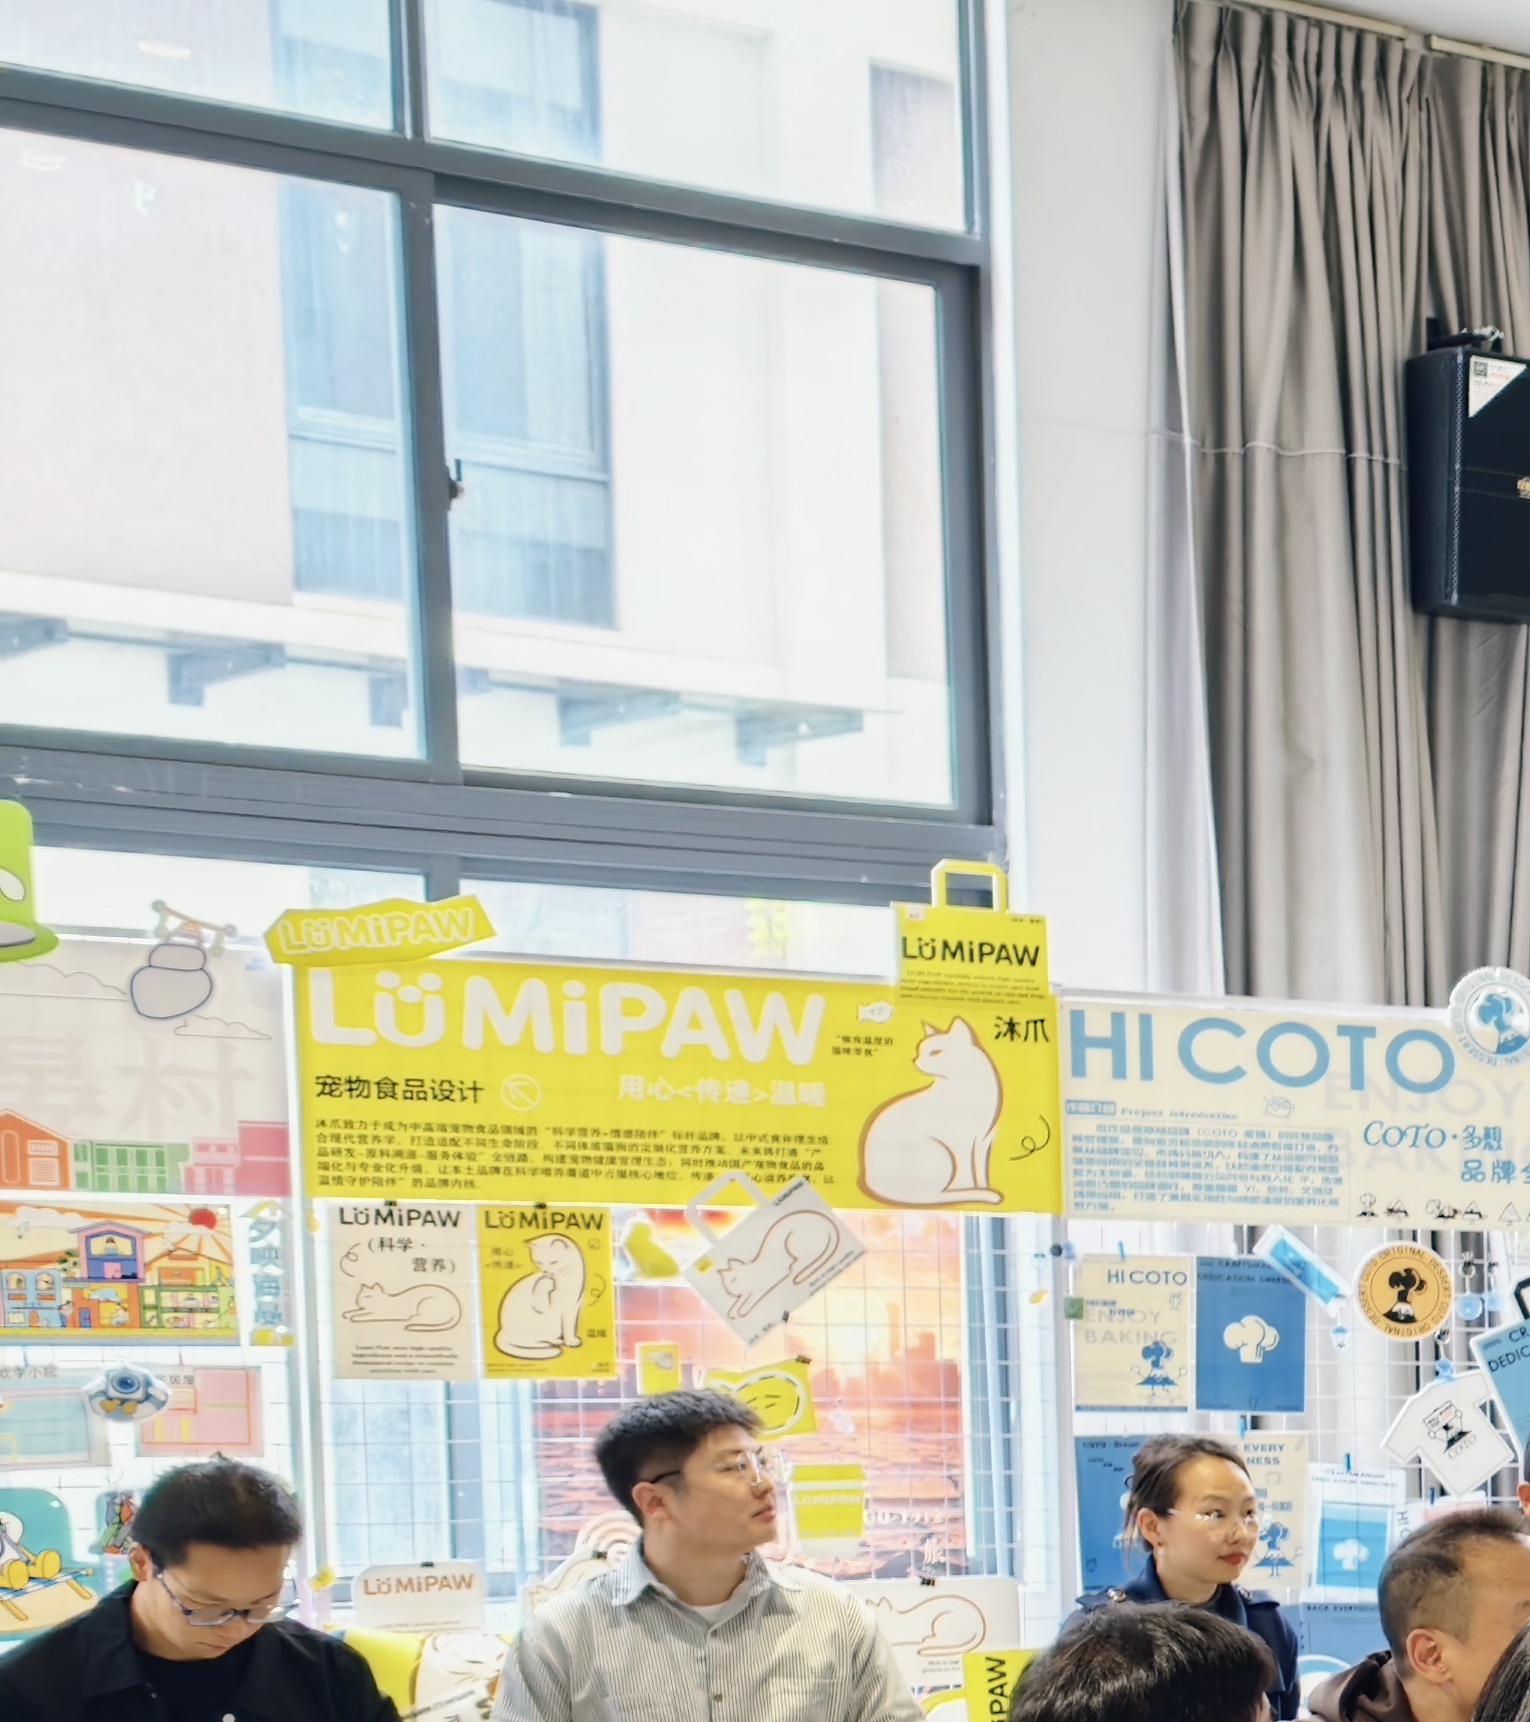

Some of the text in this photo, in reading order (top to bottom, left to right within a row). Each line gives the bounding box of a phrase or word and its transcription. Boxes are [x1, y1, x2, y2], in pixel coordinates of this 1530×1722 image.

[994, 1015, 1050, 1043] 沐爪
[1069, 1009, 1456, 1095] HI COTO
[315, 1073, 485, 1104] 宠物食品设计
[1107, 1268, 1188, 1286] HI COTO
[1244, 1442, 1286, 1453] EVERY
